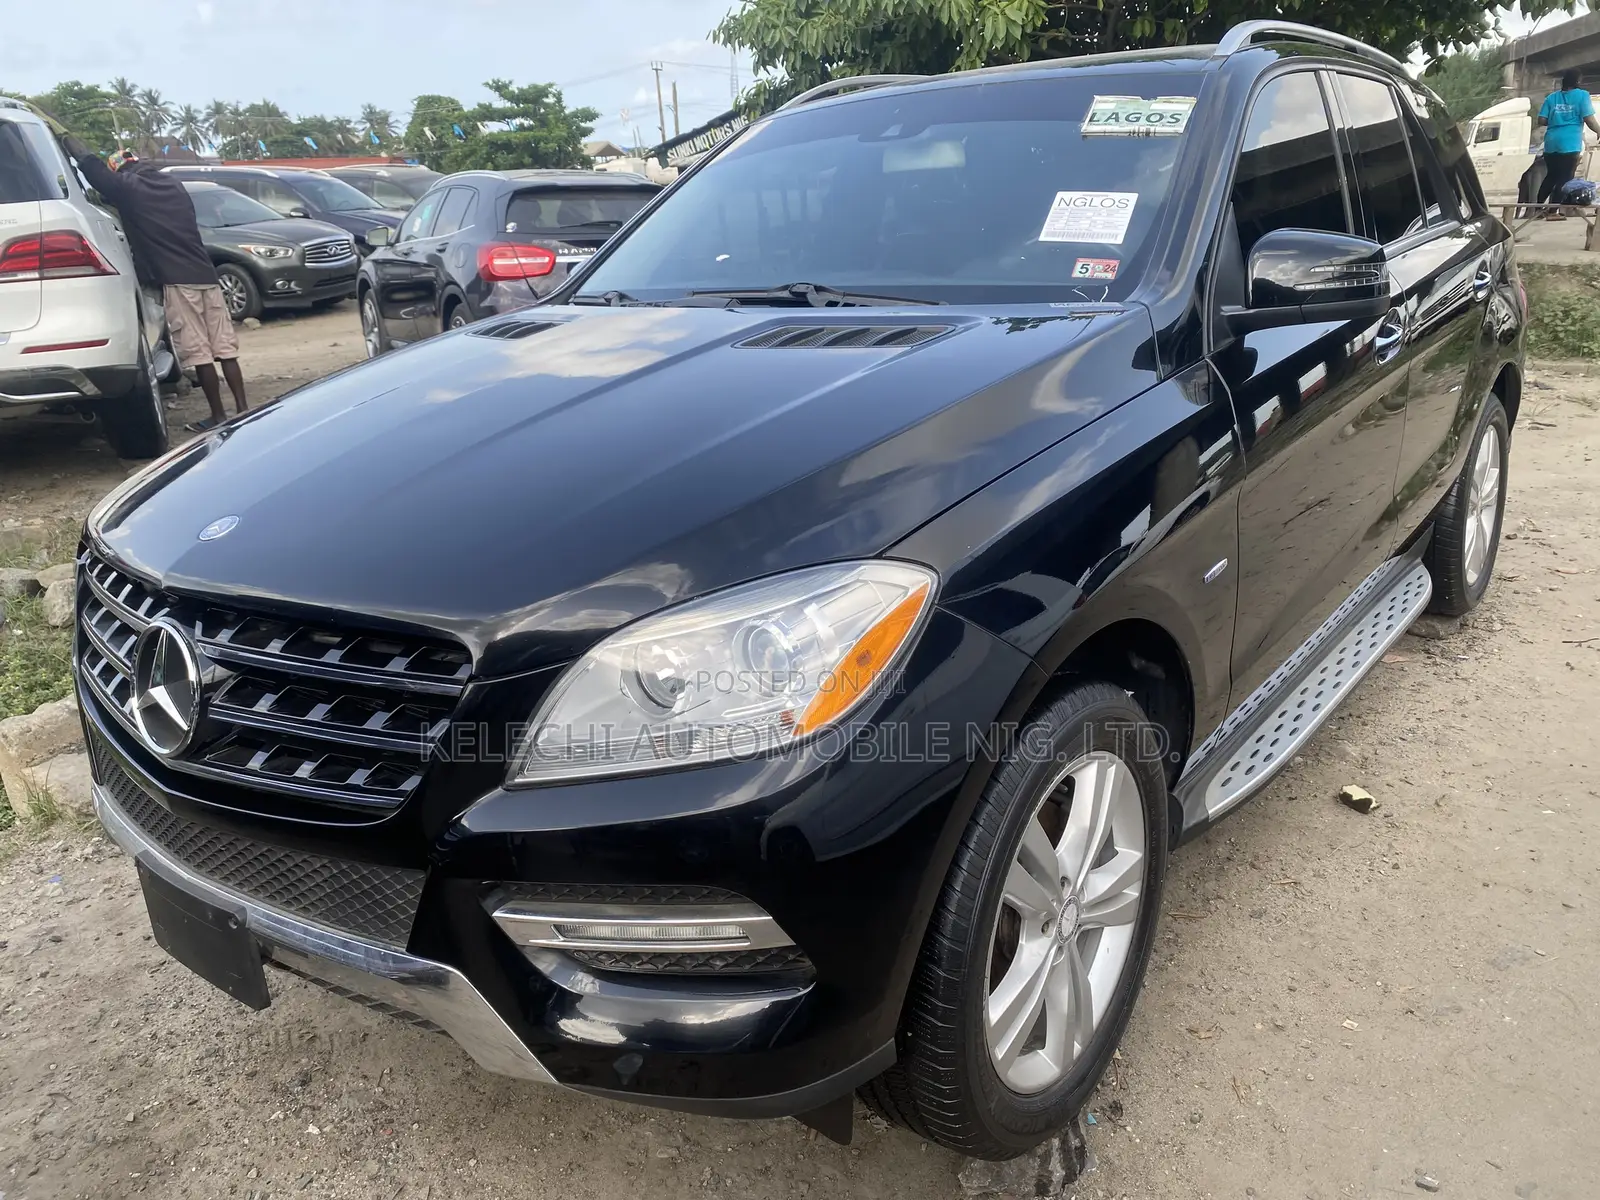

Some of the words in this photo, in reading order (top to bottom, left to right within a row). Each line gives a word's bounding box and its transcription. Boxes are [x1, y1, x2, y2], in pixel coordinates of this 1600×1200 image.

[1088, 112, 1182, 124] LAGOS
[693, 122, 733, 152] MOTORS
[1058, 197, 1130, 209] NGLOS
[1078, 263, 1090, 275] 5
[1104, 264, 1117, 273] 24
